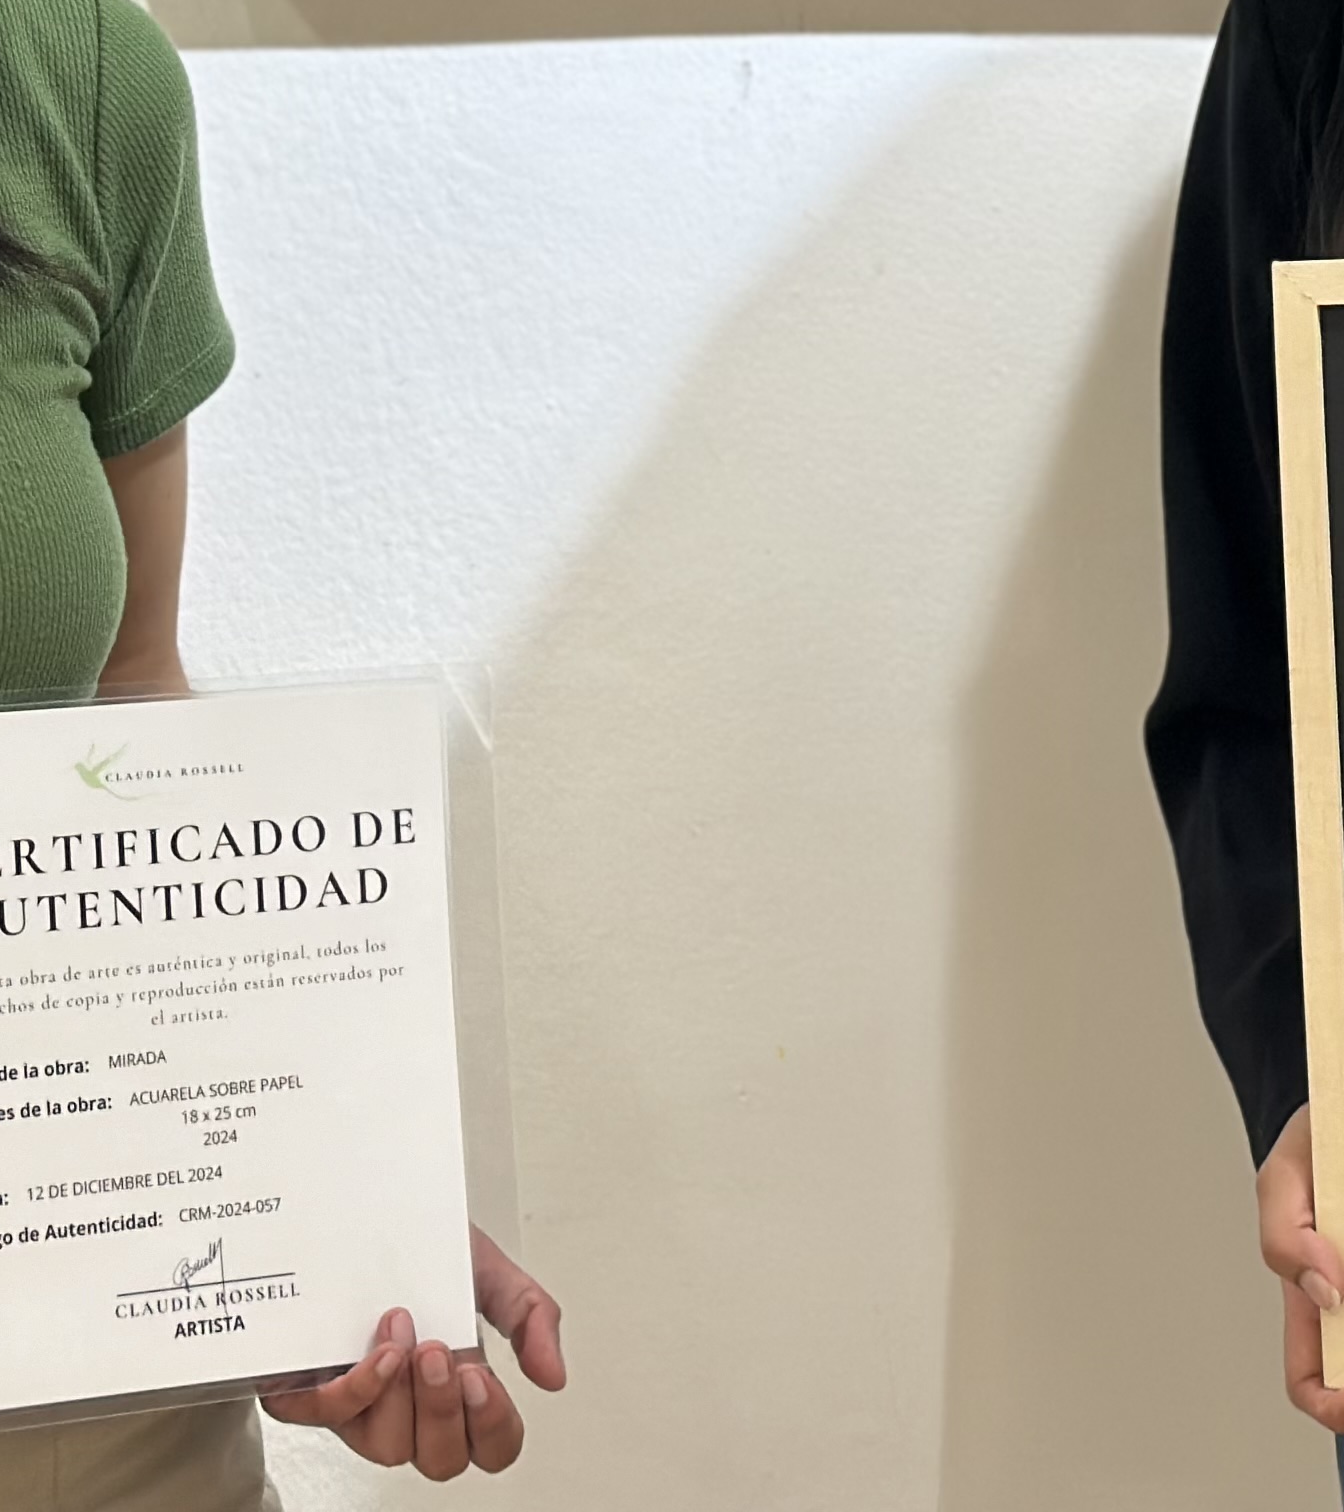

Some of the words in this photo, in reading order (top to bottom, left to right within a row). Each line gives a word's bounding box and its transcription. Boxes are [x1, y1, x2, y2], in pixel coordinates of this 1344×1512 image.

[106, 770, 172, 782] CLAUDIA
[181, 763, 244, 777] ROSSELL
[351, 808, 417, 847] DE
[20, 970, 56, 986] obra
[63, 966, 81, 981] de
[88, 966, 119, 980] arte
[126, 965, 141, 976] es
[148, 956, 222, 974] auténtica
[227, 956, 236, 971] y
[317, 941, 359, 958] todos
[366, 939, 386, 953] los
[41, 994, 60, 1010] de
[66, 992, 109, 1011] copia
[116, 993, 124, 1008] y
[131, 978, 237, 1005] reproducción
[244, 973, 284, 990] están
[291, 966, 372, 986] reservados
[379, 966, 404, 982] por
[151, 1010, 164, 1026] el
[171, 1009, 228, 1025] artista.
[24, 1063, 38, 1079] la
[44, 1060, 89, 1077] obra:
[108, 1050, 167, 1069] MIRADA
[20, 1102, 41, 1118] de
[46, 1100, 61, 1116] la
[67, 1097, 112, 1113] obra:
[130, 1086, 205, 1106] ACUARELA
[210, 1080, 256, 1098] SOBRE
[261, 1075, 303, 1092] PAPEL
[182, 1110, 198, 1125] 18
[203, 1111, 210, 1122] x
[214, 1106, 231, 1121] 25
[236, 1105, 256, 1118] cm
[204, 1130, 238, 1146] 2024
[27, 1186, 44, 1201] 12
[49, 1183, 68, 1198] DE
[73, 1174, 153, 1196] DICIEMBRE
[157, 1170, 184, 1186] DEL
[188, 1166, 222, 1182] 2024
[19, 1227, 39, 1243] de
[45, 1212, 163, 1241] Autenticidad:
[179, 1197, 281, 1222] CRM-2024-057
[115, 1294, 206, 1319] CLAUDIA
[216, 1282, 300, 1306] ROSSELL
[175, 1315, 245, 1338] ARTISTA
